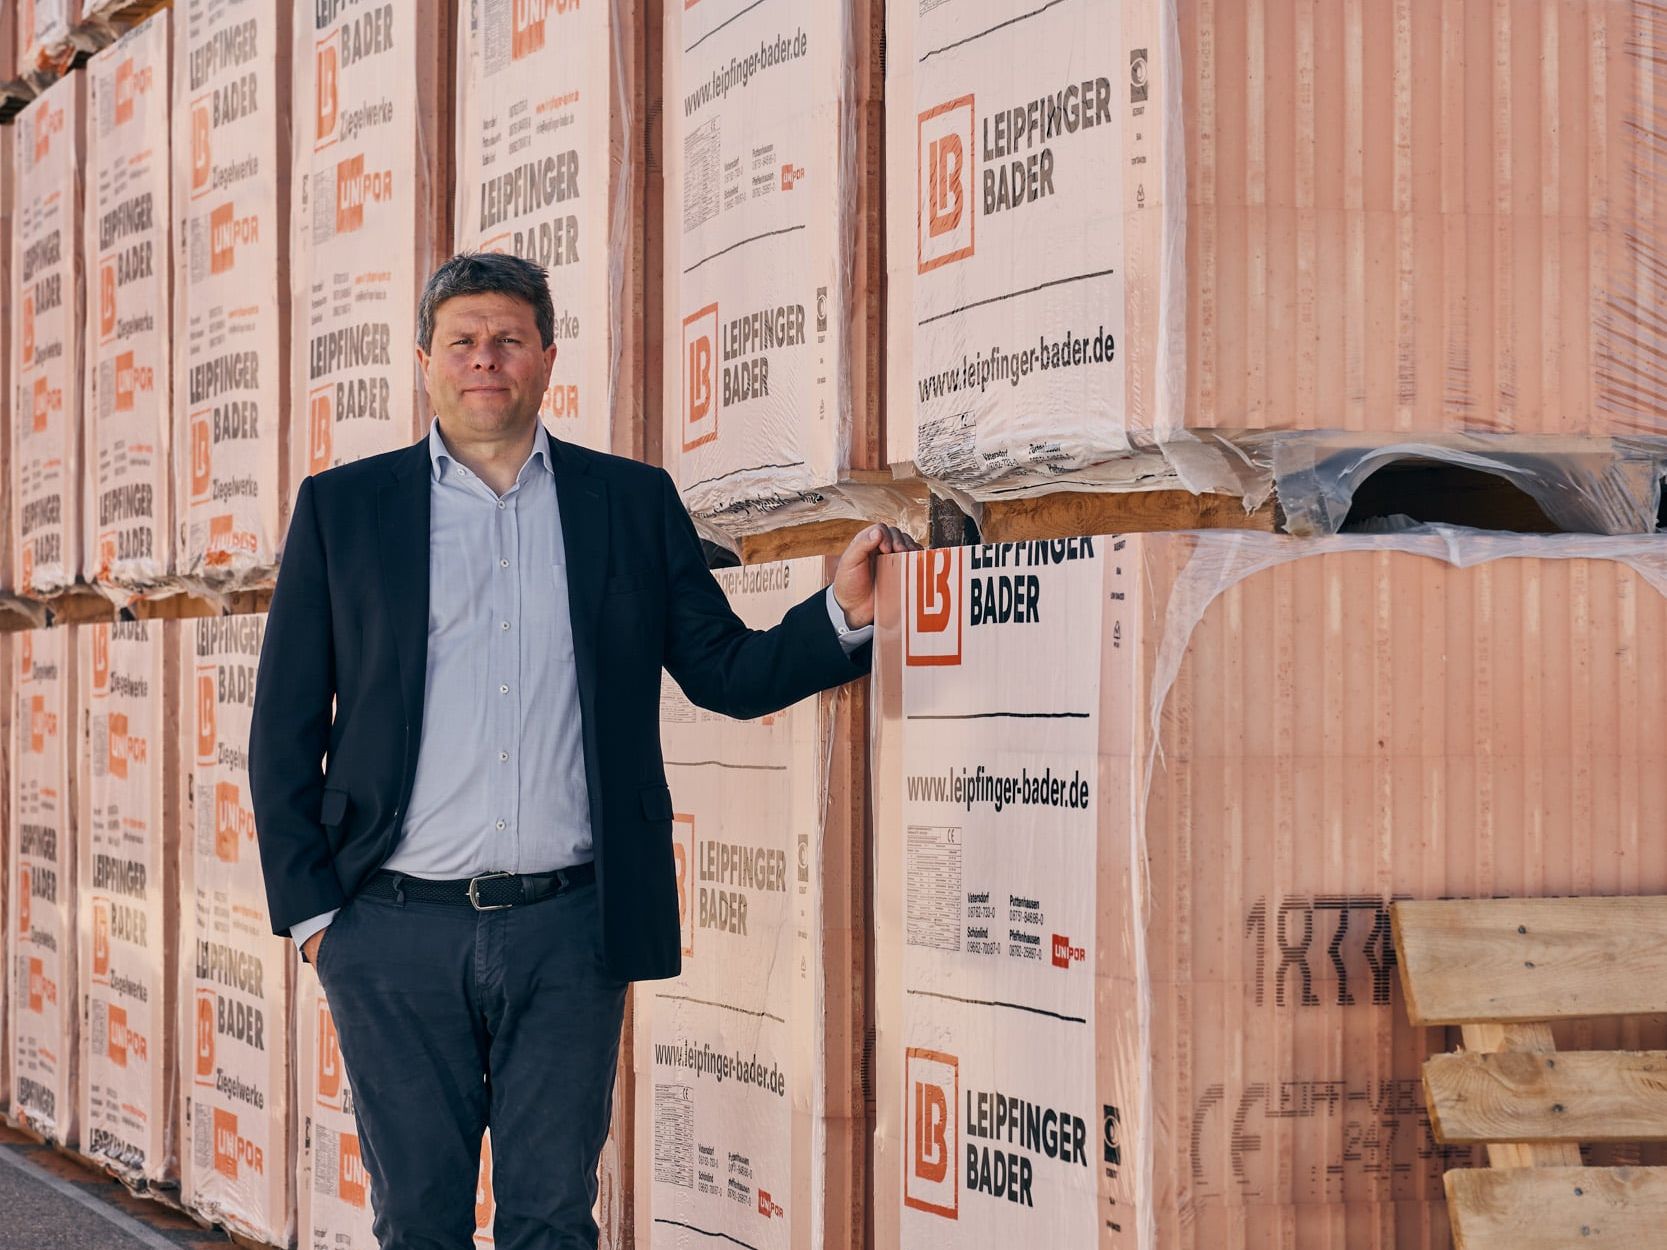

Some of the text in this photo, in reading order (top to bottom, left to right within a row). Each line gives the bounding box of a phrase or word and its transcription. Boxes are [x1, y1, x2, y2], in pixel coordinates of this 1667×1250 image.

[190, 18, 257, 91] LEIPFINGER
[341, 4, 393, 69] BADER
[684, 26, 807, 117] www.leipfinger-bader.de
[213, 72, 258, 129] BADER
[983, 77, 1112, 162] LEIPFINGER
[340, 170, 392, 210] UNIPOR
[480, 149, 580, 232] LEIPFINGER
[983, 148, 1055, 216] BADER
[311, 323, 391, 380] LEIPFINGER
[723, 303, 806, 361] LEIPFINGER
[190, 351, 259, 405] LEIPFINGER
[723, 356, 769, 408] BADER
[918, 325, 1115, 402] www.leipfinger-bader.de
[213, 401, 259, 444] BADER
[336, 377, 391, 422] BADER
[719, 560, 791, 596] ger-bader.de
[970, 575, 1041, 626] BADER
[218, 664, 256, 708] BADE
[907, 765, 1089, 813] www.leipfinger-bader.de
[219, 801, 255, 842] UNIPO
[700, 840, 786, 892] LEIPFINGER
[700, 887, 748, 936] BADER
[196, 938, 264, 999] LEIPFINGER
[1054, 944, 1086, 962] UNIPOR
[217, 995, 265, 1050] BADER
[216, 1067, 264, 1110] Ziegelwerke
[655, 1039, 785, 1097] www.leipfinger-bader.de
[217, 1127, 264, 1176] UNIPOR
[967, 1089, 1088, 1168] LEIPFINGER
[967, 1143, 1034, 1208] BADER
